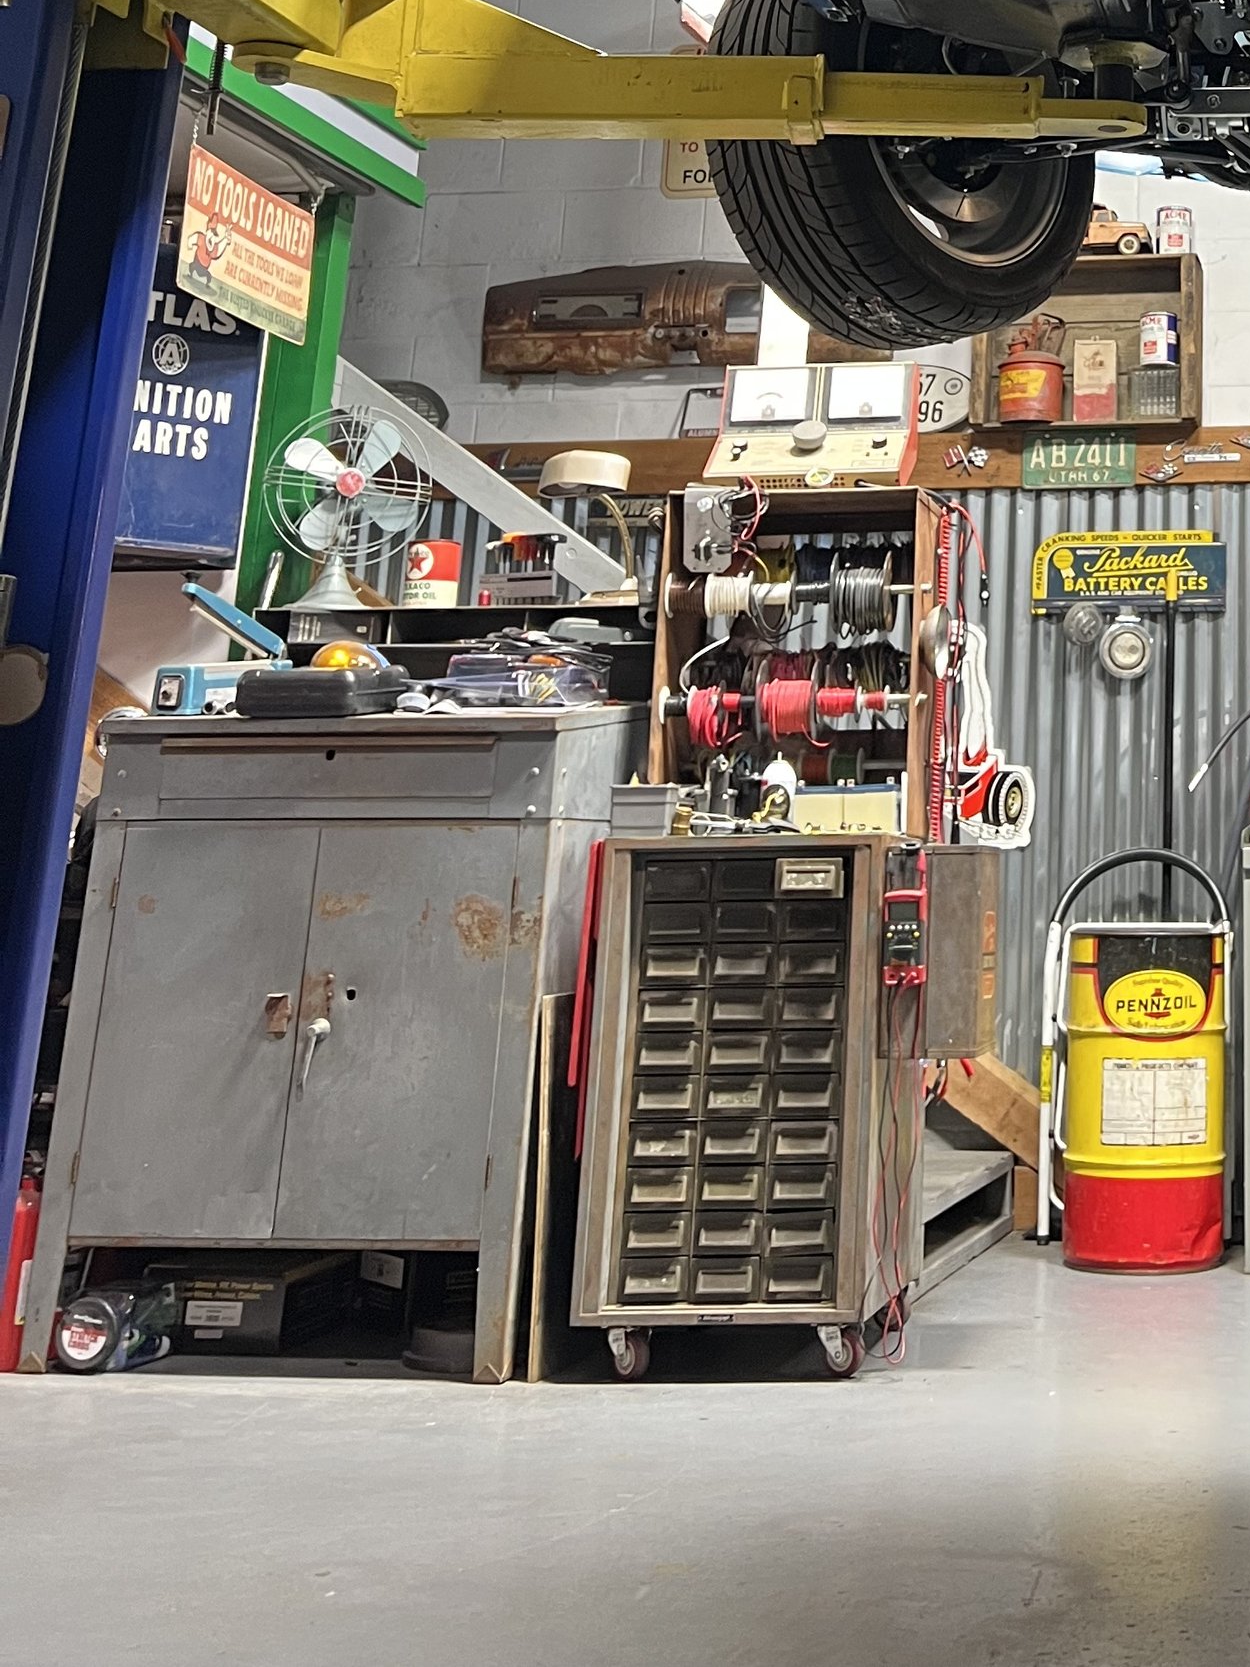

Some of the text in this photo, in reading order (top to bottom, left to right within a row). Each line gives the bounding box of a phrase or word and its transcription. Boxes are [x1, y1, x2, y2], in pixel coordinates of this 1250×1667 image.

[680, 142, 699, 153] TO
[683, 169, 711, 184] FO
[191, 157, 311, 259] NO TOOLS LOANED
[1163, 209, 1189, 221] ACME
[133, 379, 232, 425] NITION
[132, 419, 209, 461] ARTS
[1049, 470, 1089, 483] UTAH
[1041, 534, 1087, 553] CRANKING
[1091, 534, 1119, 542] SPEEDS
[1131, 533, 1168, 542] QUICKER
[1172, 533, 1202, 541] STARTS
[1083, 546, 1194, 573] Packard
[1063, 576, 1208, 591] BATTERY CALES
[1115, 995, 1198, 1014] PENNZOIL
